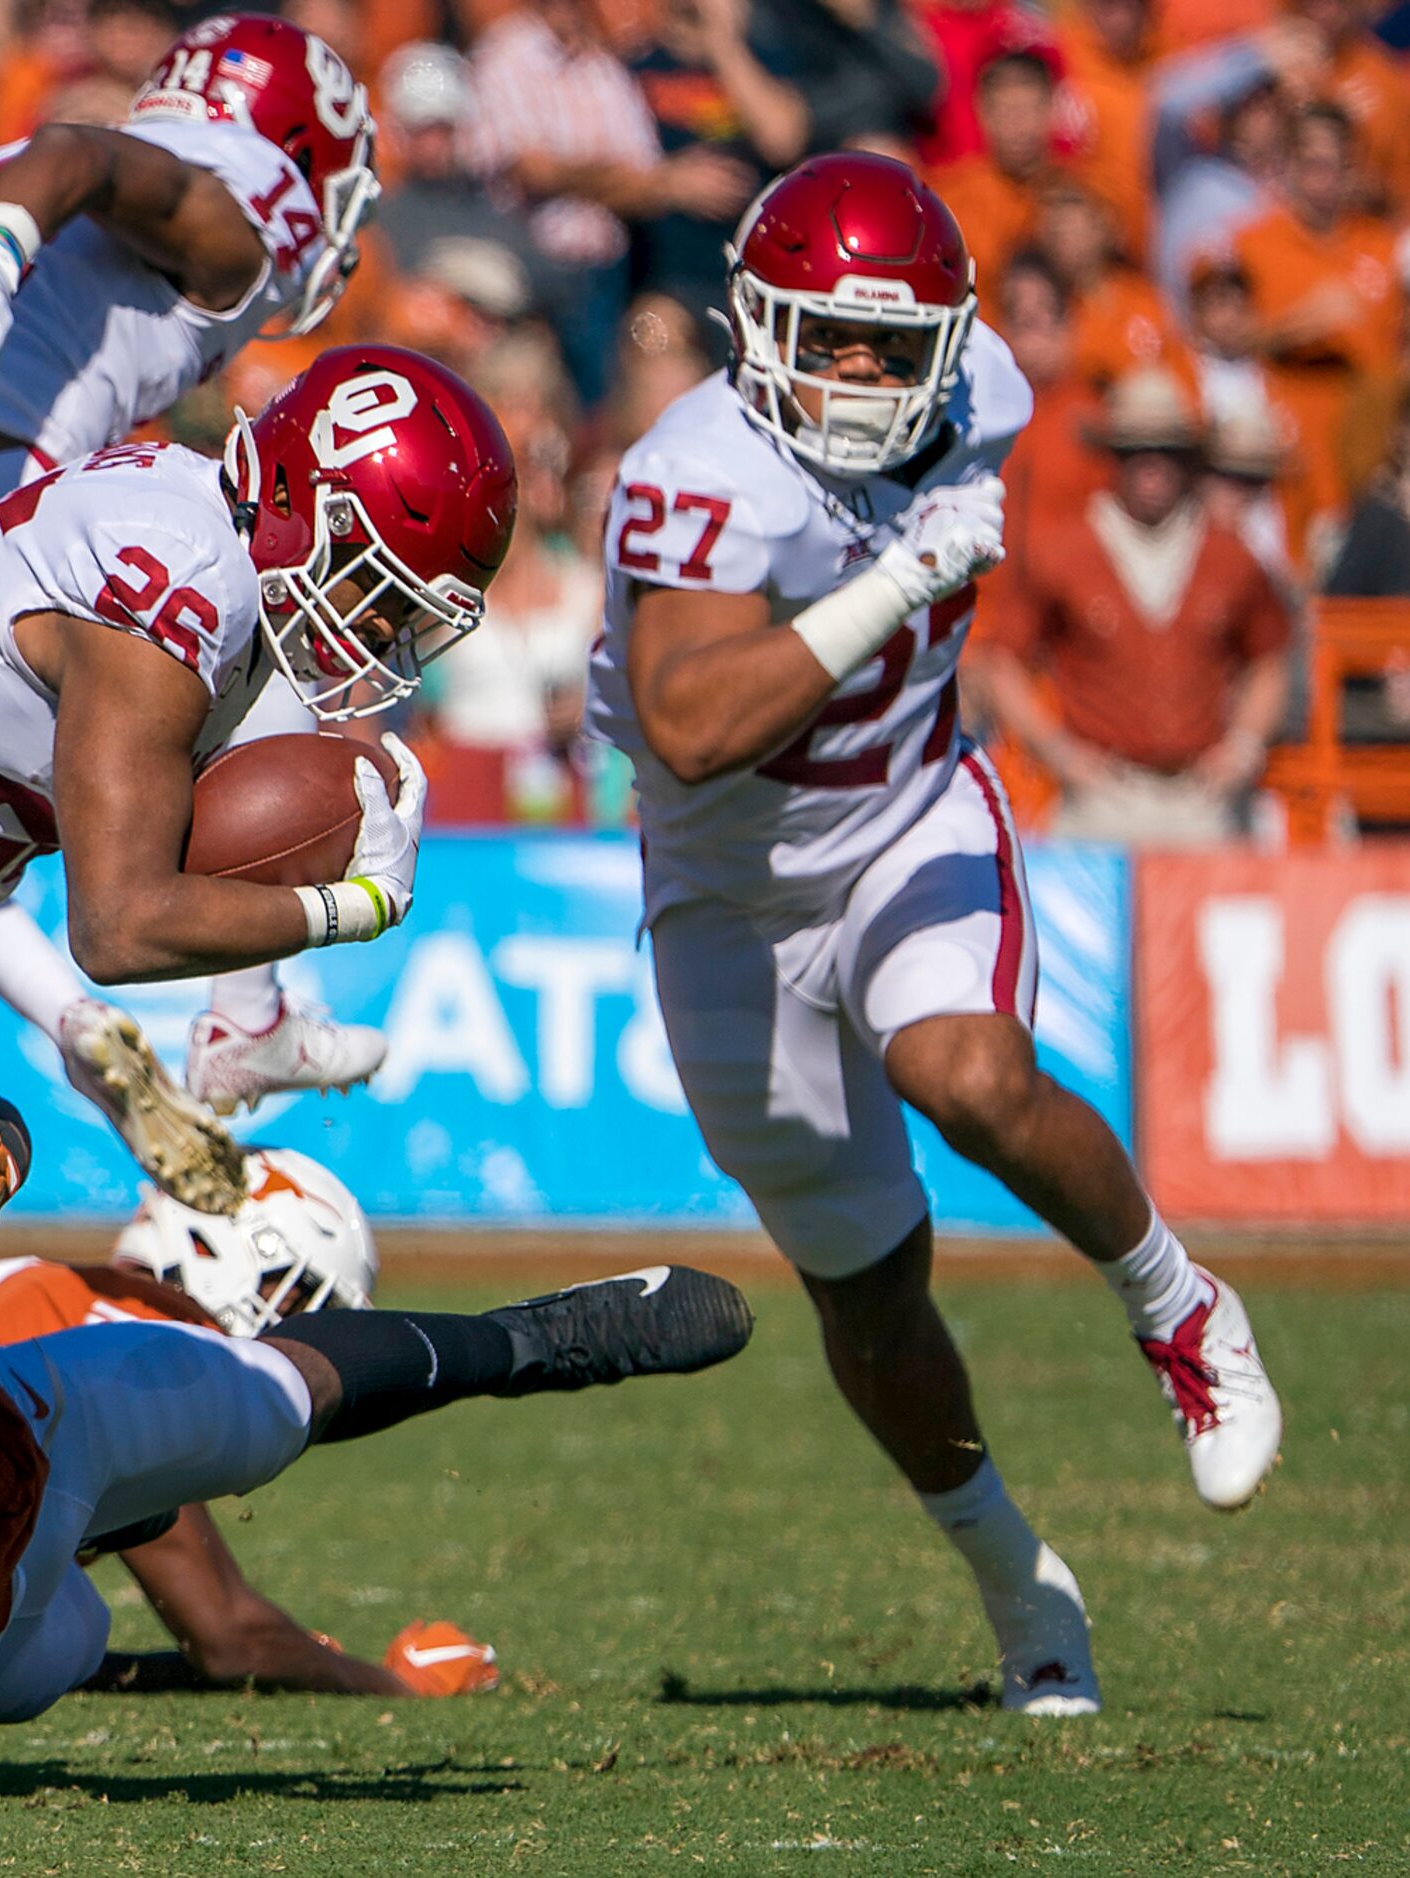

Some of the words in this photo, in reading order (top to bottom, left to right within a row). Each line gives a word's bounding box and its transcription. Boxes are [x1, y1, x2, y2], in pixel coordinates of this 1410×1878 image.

[164, 48, 214, 93] 14
[249, 165, 322, 273] 14
[617, 481, 732, 581] 27
[94, 546, 220, 672] 26
[1195, 893, 1410, 1162] LO
